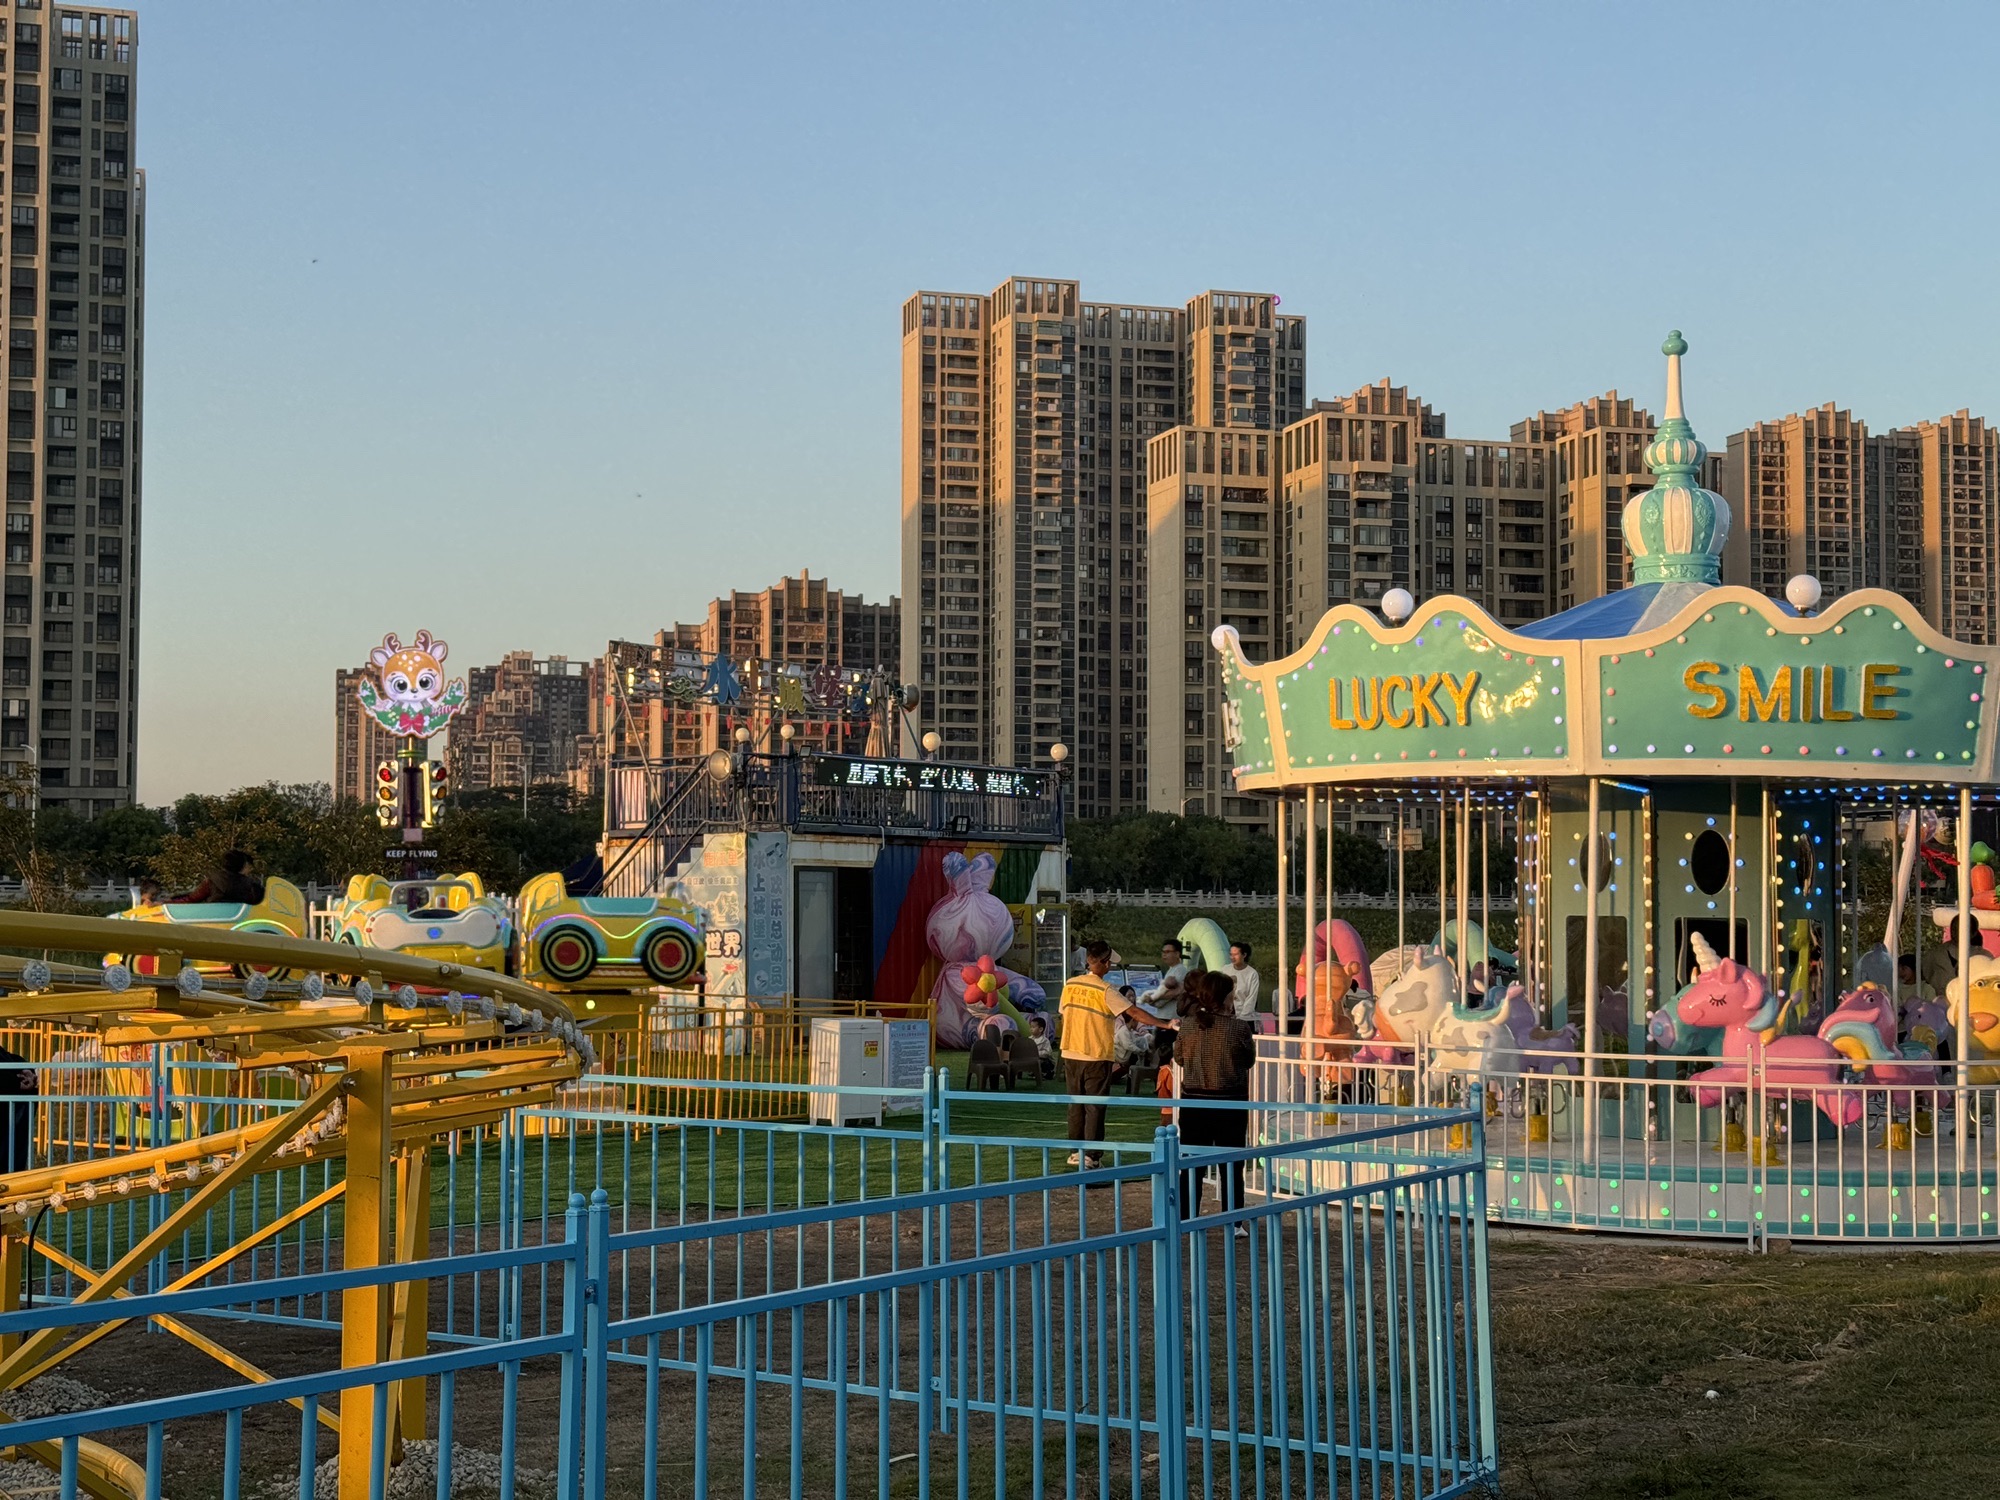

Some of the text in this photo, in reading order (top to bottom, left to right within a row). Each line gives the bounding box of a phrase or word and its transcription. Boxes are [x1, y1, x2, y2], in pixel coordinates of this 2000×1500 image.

[1328, 670, 1480, 730] LUCKY
[1682, 661, 1900, 722] SMILE
[386, 850, 438, 858] KEEP FLYING
[753, 851, 767, 939] 水上城堡
[705, 929, 742, 958] 世界
[769, 875, 784, 986] 欢乐总动员
